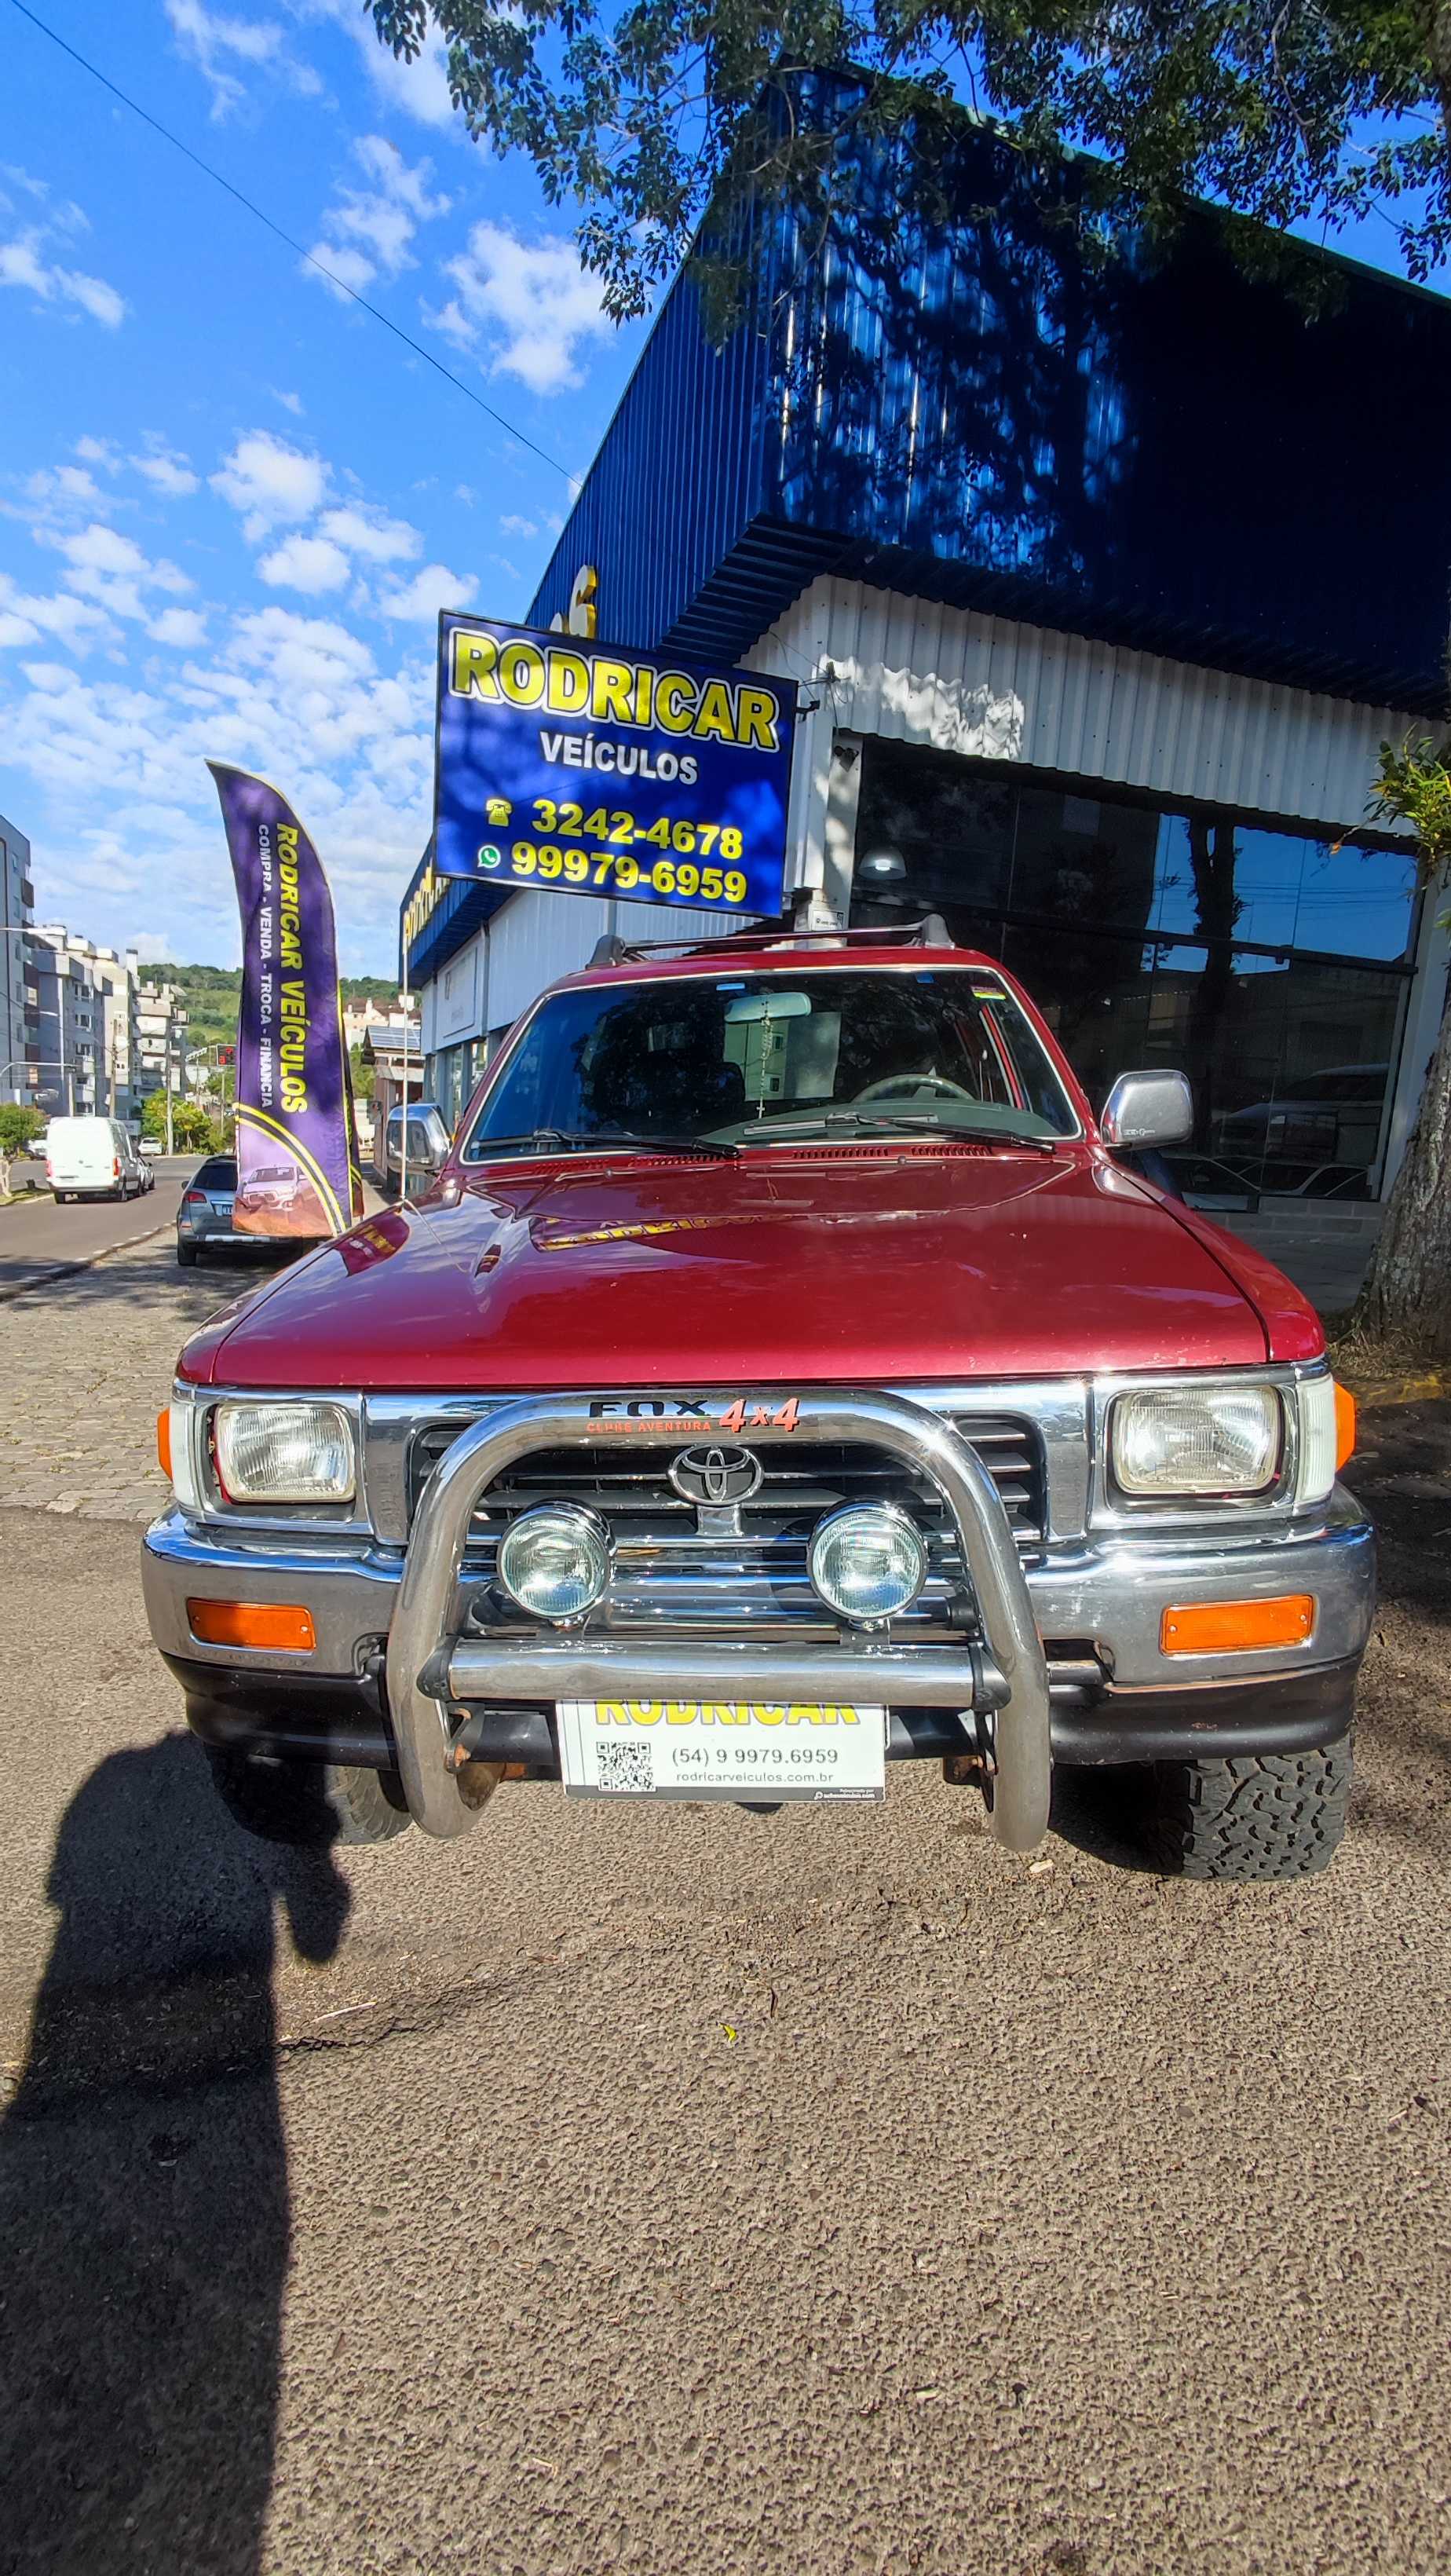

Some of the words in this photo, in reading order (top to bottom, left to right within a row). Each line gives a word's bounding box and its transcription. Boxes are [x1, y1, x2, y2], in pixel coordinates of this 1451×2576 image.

[451, 629, 779, 751] RODRICAR
[540, 732, 698, 785] VEÍCULOS
[532, 799, 743, 859] 3242-4678
[258, 825, 272, 892] COMPRA
[511, 841, 747, 902] 99979-6959
[276, 823, 302, 970] RODRICAR
[261, 906, 272, 960] VENDA
[261, 973, 272, 1024] TROCA
[260, 1037, 273, 1108] FINANCIA
[280, 980, 311, 1113] VEÍCULOS
[590, 1400, 711, 1418] FOX
[638, 1420, 711, 1433] AVENTURA
[672, 1748, 710, 1766] (54)
[716, 1749, 727, 1763] 9
[735, 1749, 839, 1764] 9979.6959
[676, 1771, 834, 1783] rodricarveiculos.com.br
